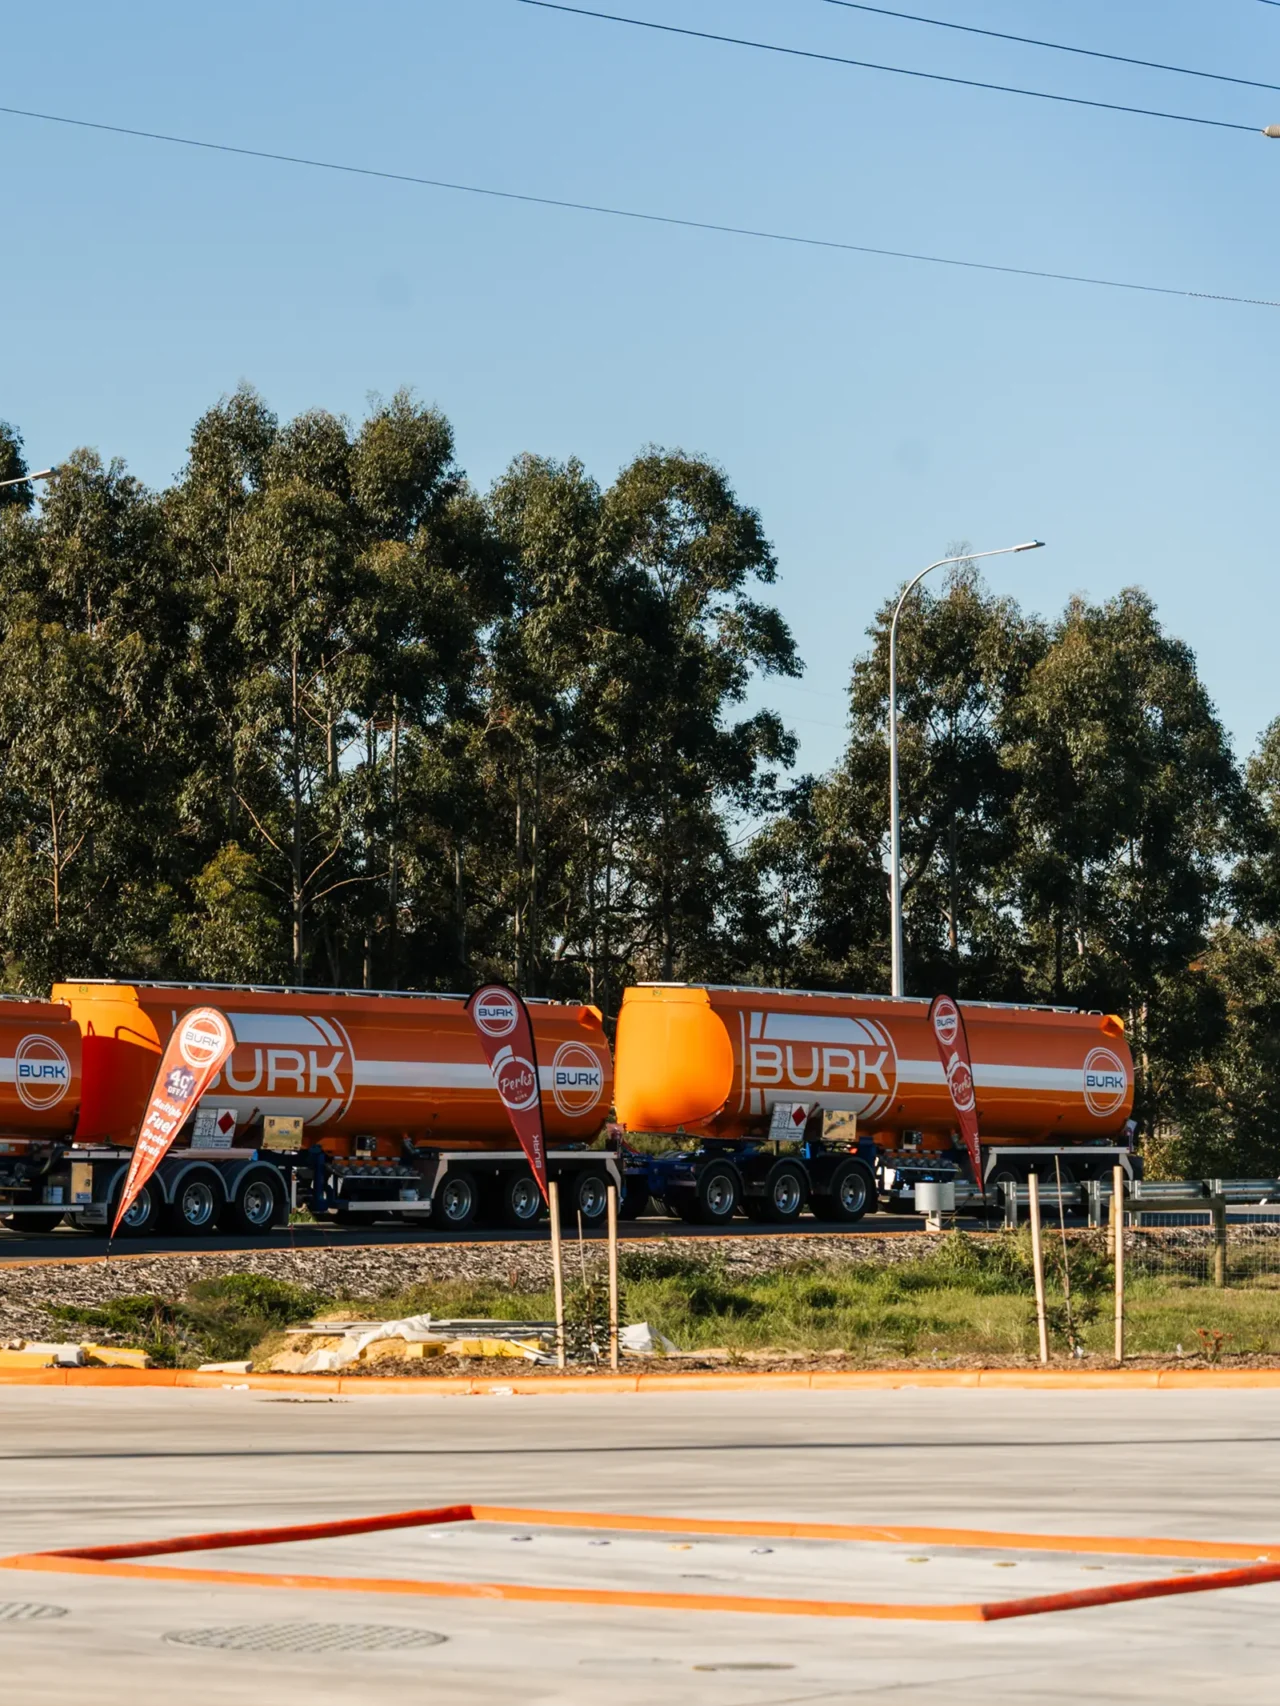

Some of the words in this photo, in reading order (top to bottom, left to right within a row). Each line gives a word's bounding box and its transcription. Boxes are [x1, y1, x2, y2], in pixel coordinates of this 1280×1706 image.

[478, 1008, 514, 1017] BURK
[937, 1018, 956, 1027] BURK
[185, 1031, 219, 1048] BURK
[19, 1064, 66, 1079] BURK
[205, 1048, 344, 1094] URK
[750, 1043, 889, 1090] BURK
[500, 1070, 533, 1094] Perks
[556, 1072, 599, 1085] BURK
[952, 1075, 971, 1097] Perks
[1086, 1075, 1124, 1088] BURK
[152, 1098, 182, 1118] Multiple
[146, 1111, 177, 1134] Fuel
[533, 1134, 541, 1168] BURK
